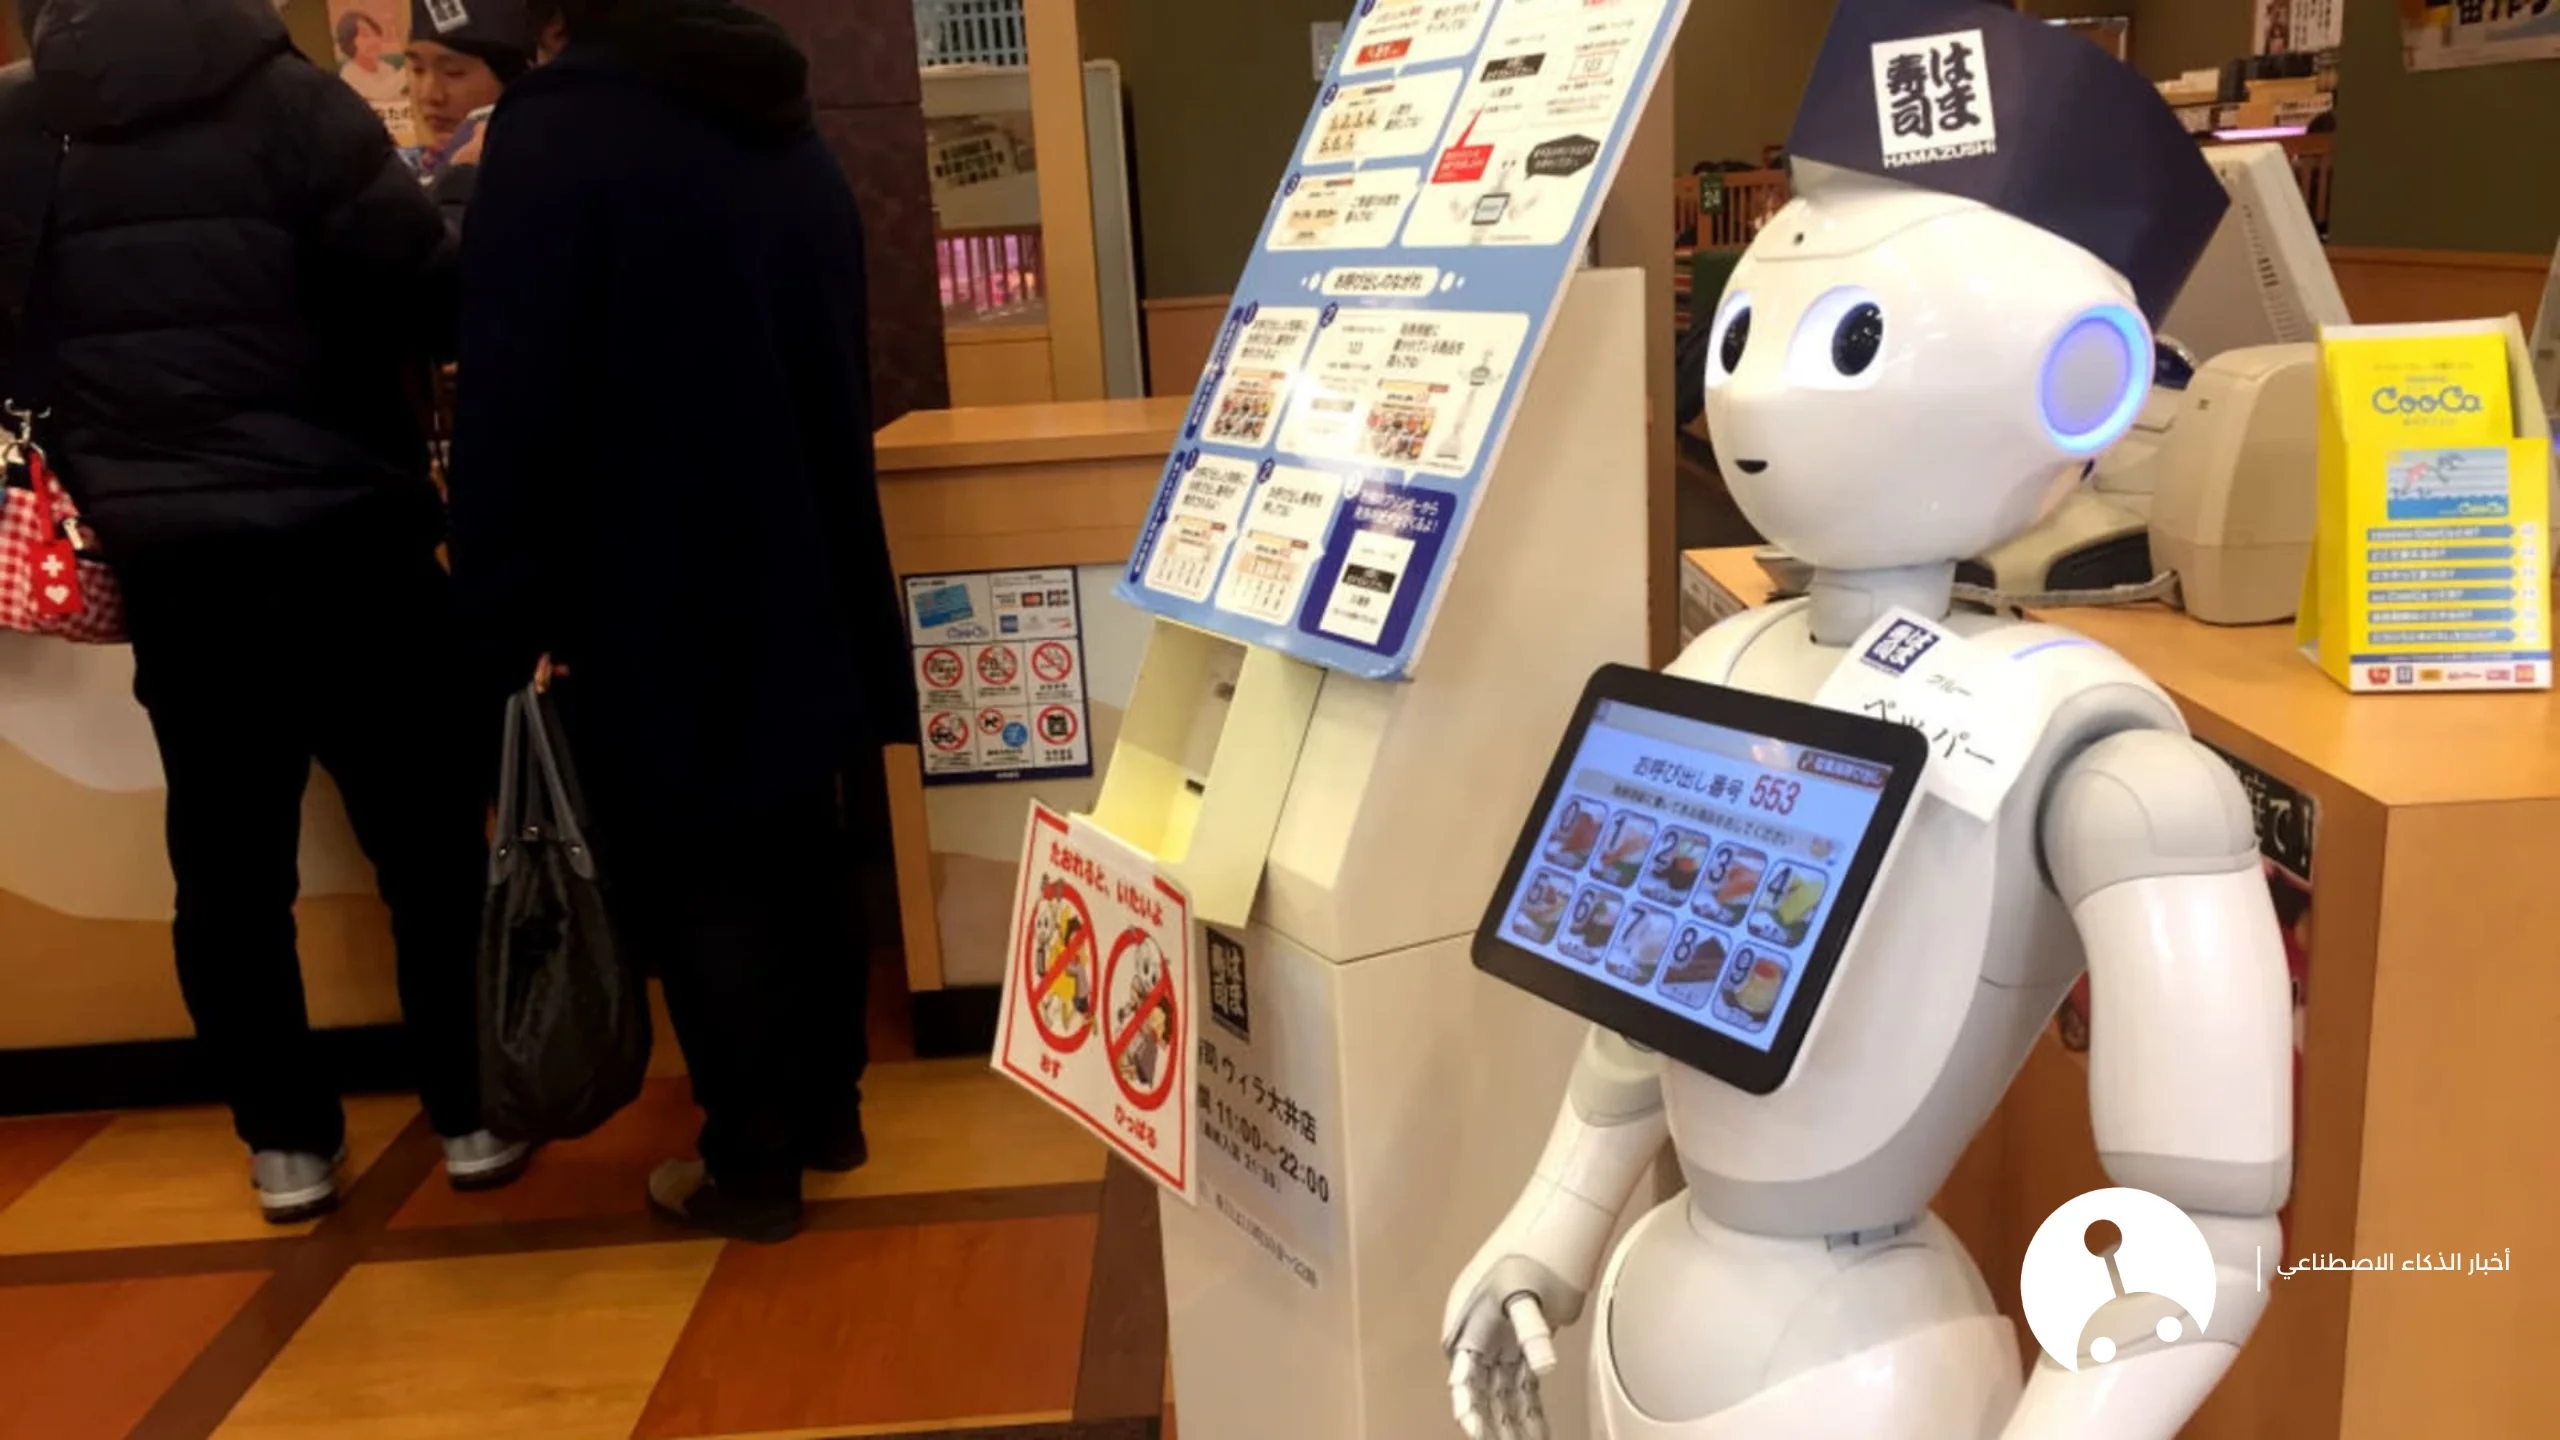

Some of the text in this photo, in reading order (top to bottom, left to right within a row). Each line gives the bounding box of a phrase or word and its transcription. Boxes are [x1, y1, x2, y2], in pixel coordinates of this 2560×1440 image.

[1887, 54, 1933, 138] 寿司
[1930, 42, 1981, 131] はま
[1883, 139, 1997, 168] HAMAZUSHI
[2371, 384, 2484, 416] CooCa
[1632, 755, 1801, 816] お呼び出し番号 553
[1559, 801, 1580, 833] 0
[1608, 811, 1626, 848] 1
[1654, 830, 1680, 867] 2
[1708, 847, 1733, 884] 3
[1526, 872, 1549, 905] 5
[1767, 867, 1793, 905] 4
[1572, 889, 1596, 924] 6
[1621, 906, 1647, 942] 7
[1673, 927, 1699, 963] 8
[1728, 947, 1755, 985] 9
[1040, 1052, 1062, 1080] おす
[1222, 1055, 1317, 1145] ウィラ大井店
[1114, 1104, 1158, 1151] ひっぱる
